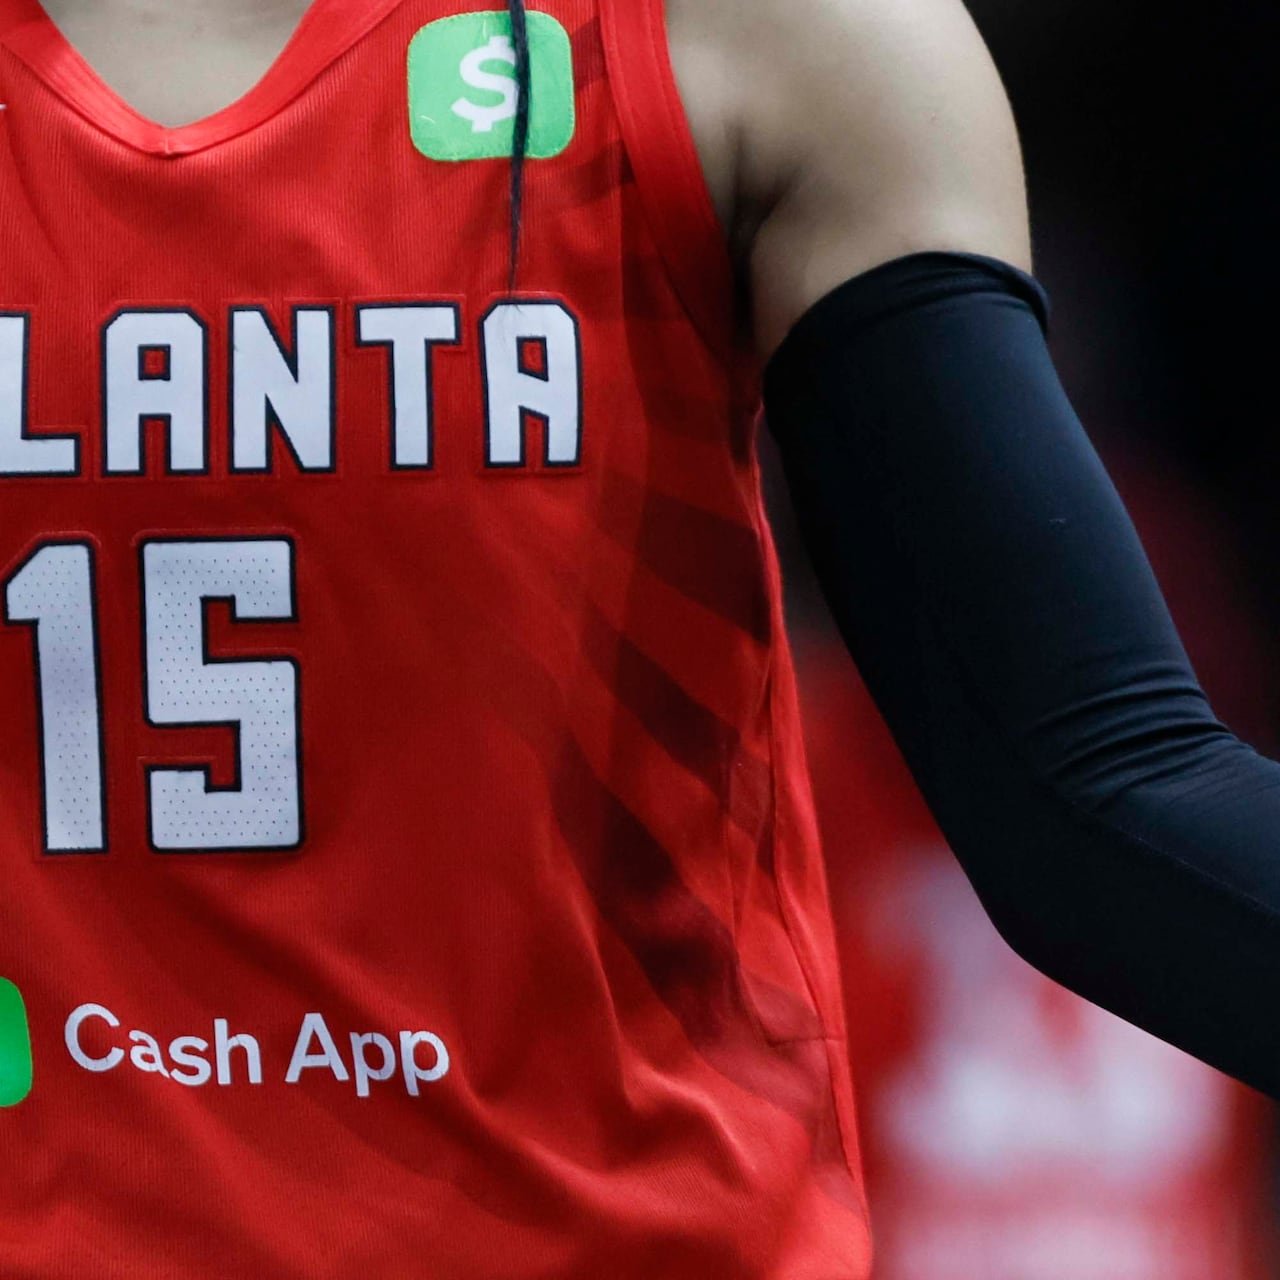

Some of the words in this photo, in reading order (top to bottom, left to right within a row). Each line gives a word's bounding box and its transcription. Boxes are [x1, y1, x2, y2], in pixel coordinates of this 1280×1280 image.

[1, 536, 306, 854] 15
[64, 1002, 263, 1086] Cash
[285, 1012, 451, 1098] App
